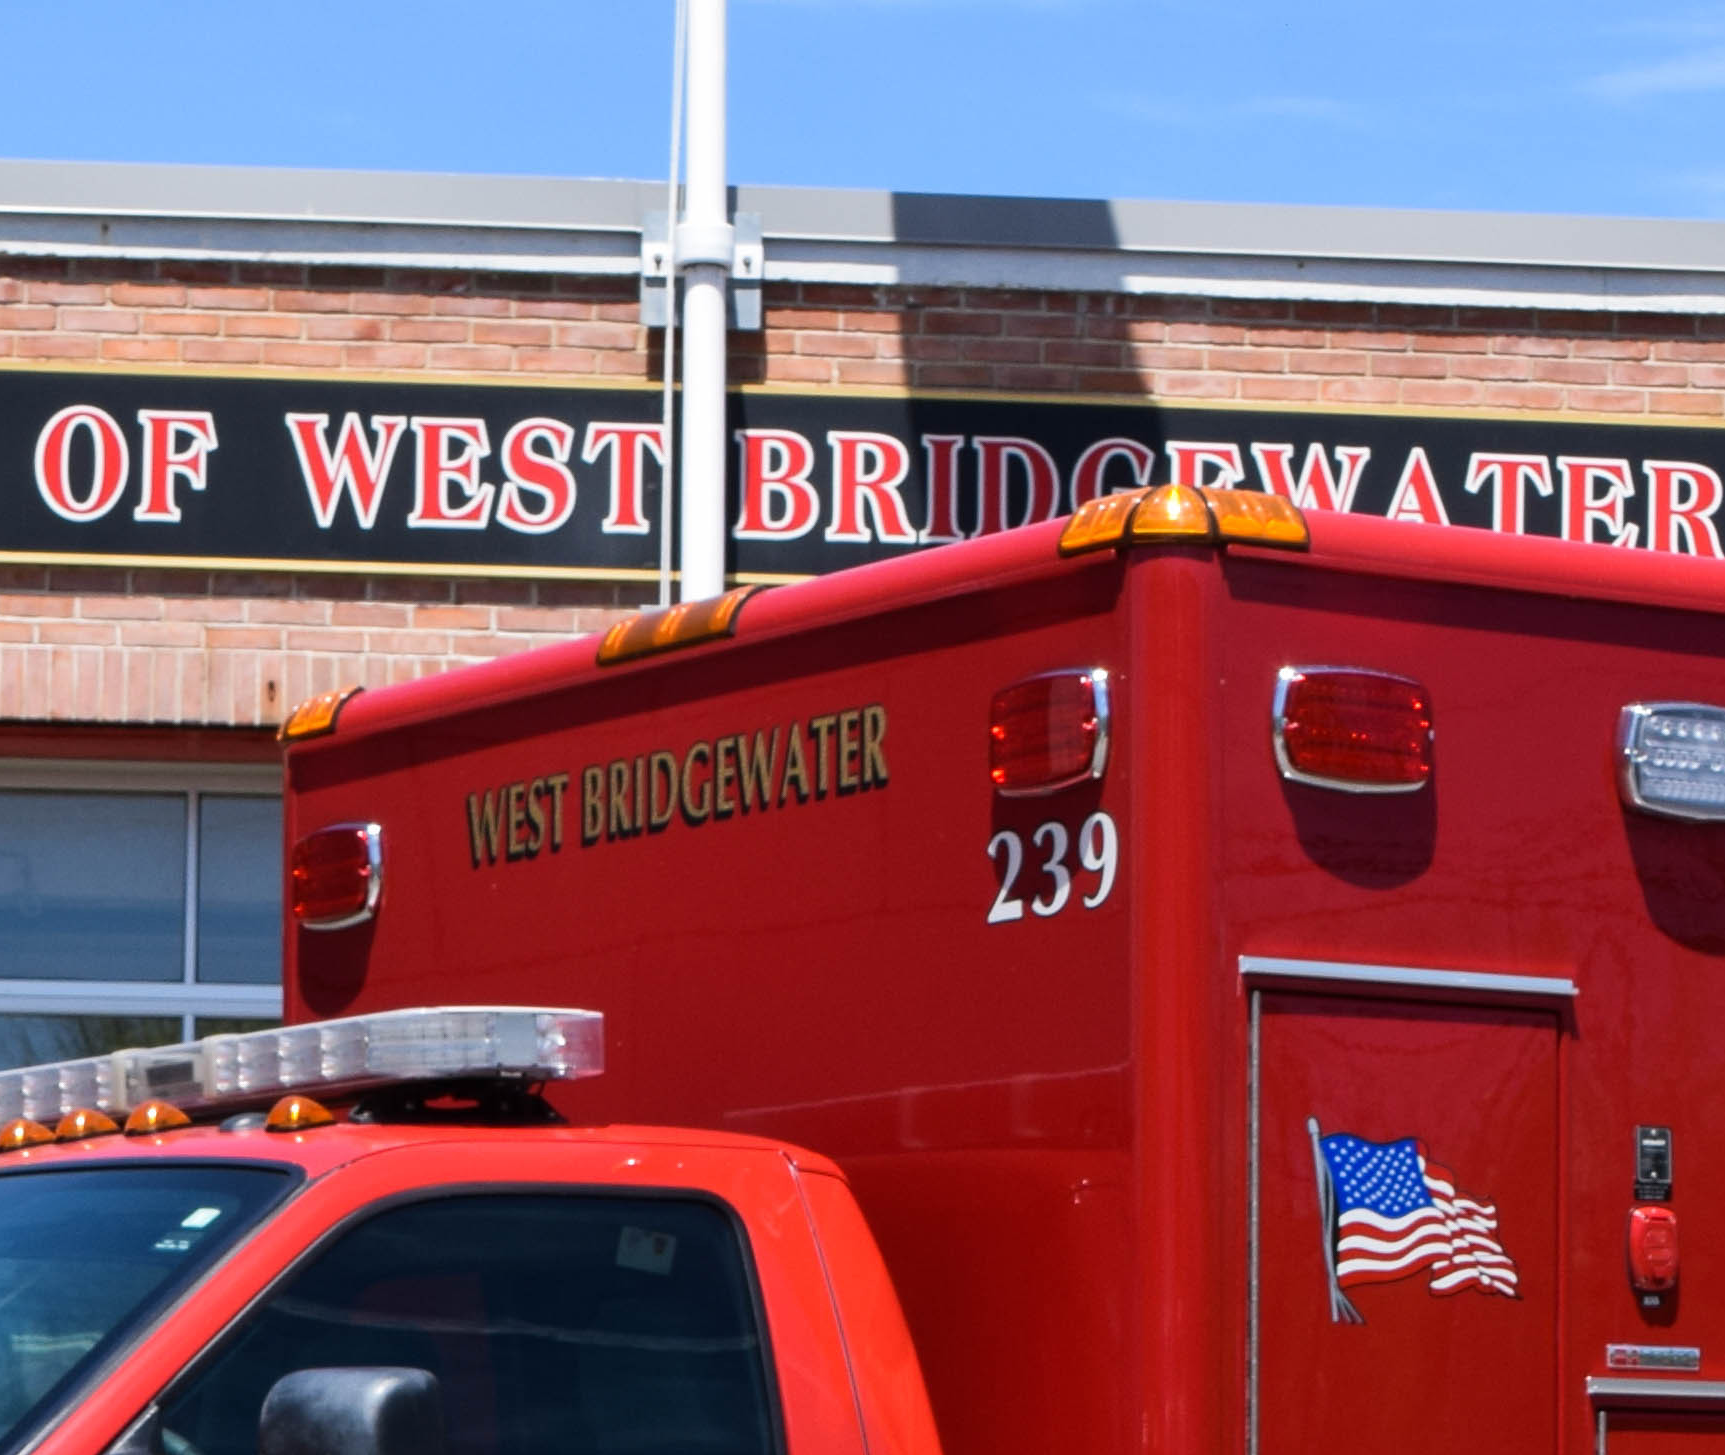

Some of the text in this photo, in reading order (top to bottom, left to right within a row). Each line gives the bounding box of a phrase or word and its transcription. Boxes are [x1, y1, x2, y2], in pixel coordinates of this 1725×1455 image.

[34, 405, 218, 522] OF
[285, 412, 667, 533] WEST
[466, 704, 890, 868] WEST BRIDGEWATER
[987, 811, 1118, 924] 239
